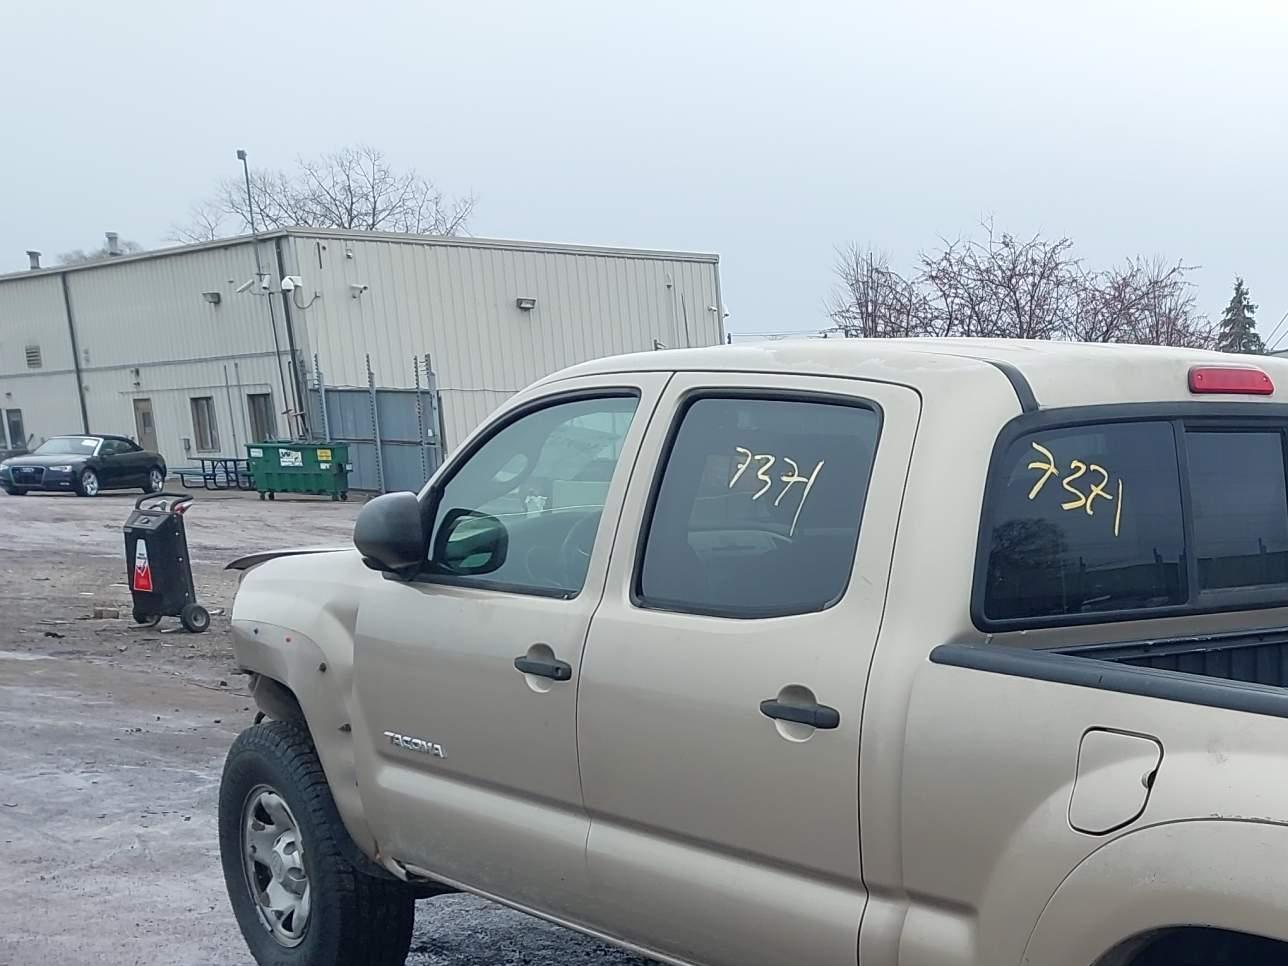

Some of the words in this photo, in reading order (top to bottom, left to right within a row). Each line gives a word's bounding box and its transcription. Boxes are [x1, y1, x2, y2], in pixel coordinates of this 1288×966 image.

[729, 447, 824, 537] 7371
[1027, 441, 1123, 537] 7371
[383, 731, 445, 758] TACOMA
